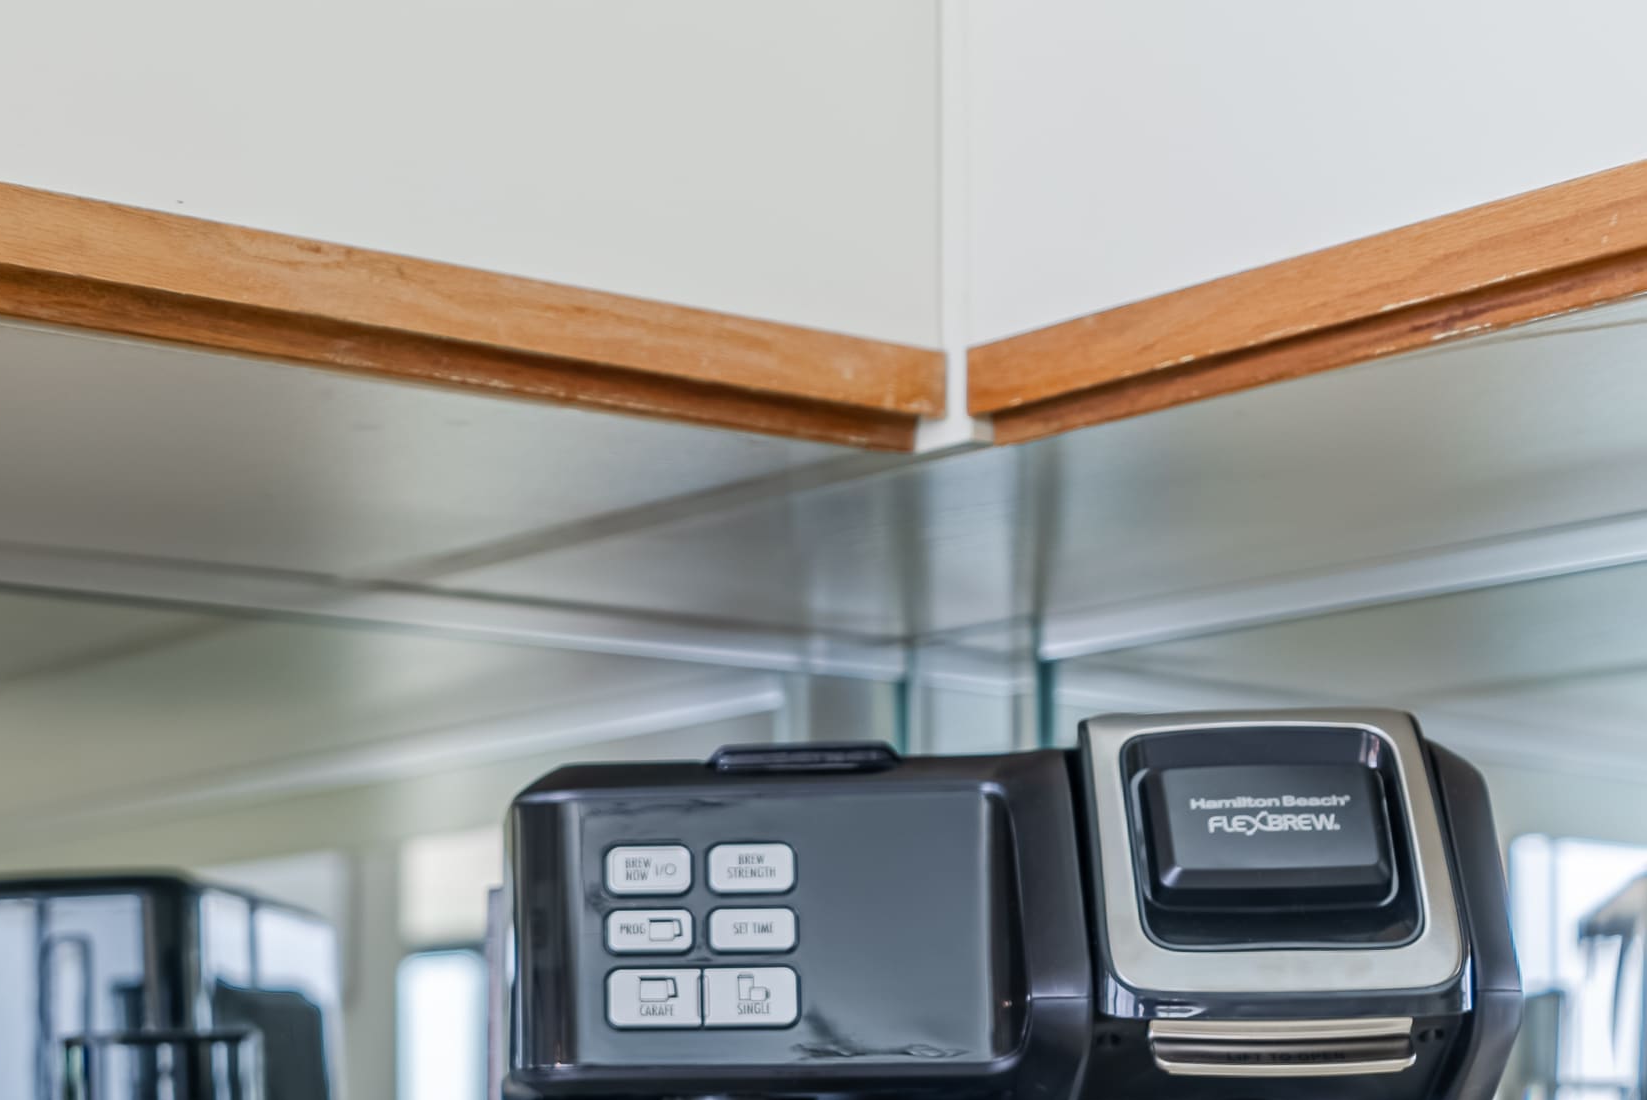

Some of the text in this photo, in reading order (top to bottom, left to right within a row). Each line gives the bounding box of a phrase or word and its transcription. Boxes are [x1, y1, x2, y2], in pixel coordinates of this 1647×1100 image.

[1190, 796, 1280, 810] Hamilton
[625, 857, 651, 868] BREW
[738, 854, 765, 865] BREW
[626, 870, 649, 881] NOW
[727, 866, 776, 878] STRENGTH
[619, 923, 646, 935] PROG
[733, 922, 774, 934] SET TIME
[639, 1004, 675, 1016] CARAFE
[737, 1003, 770, 1015] SINGLE
